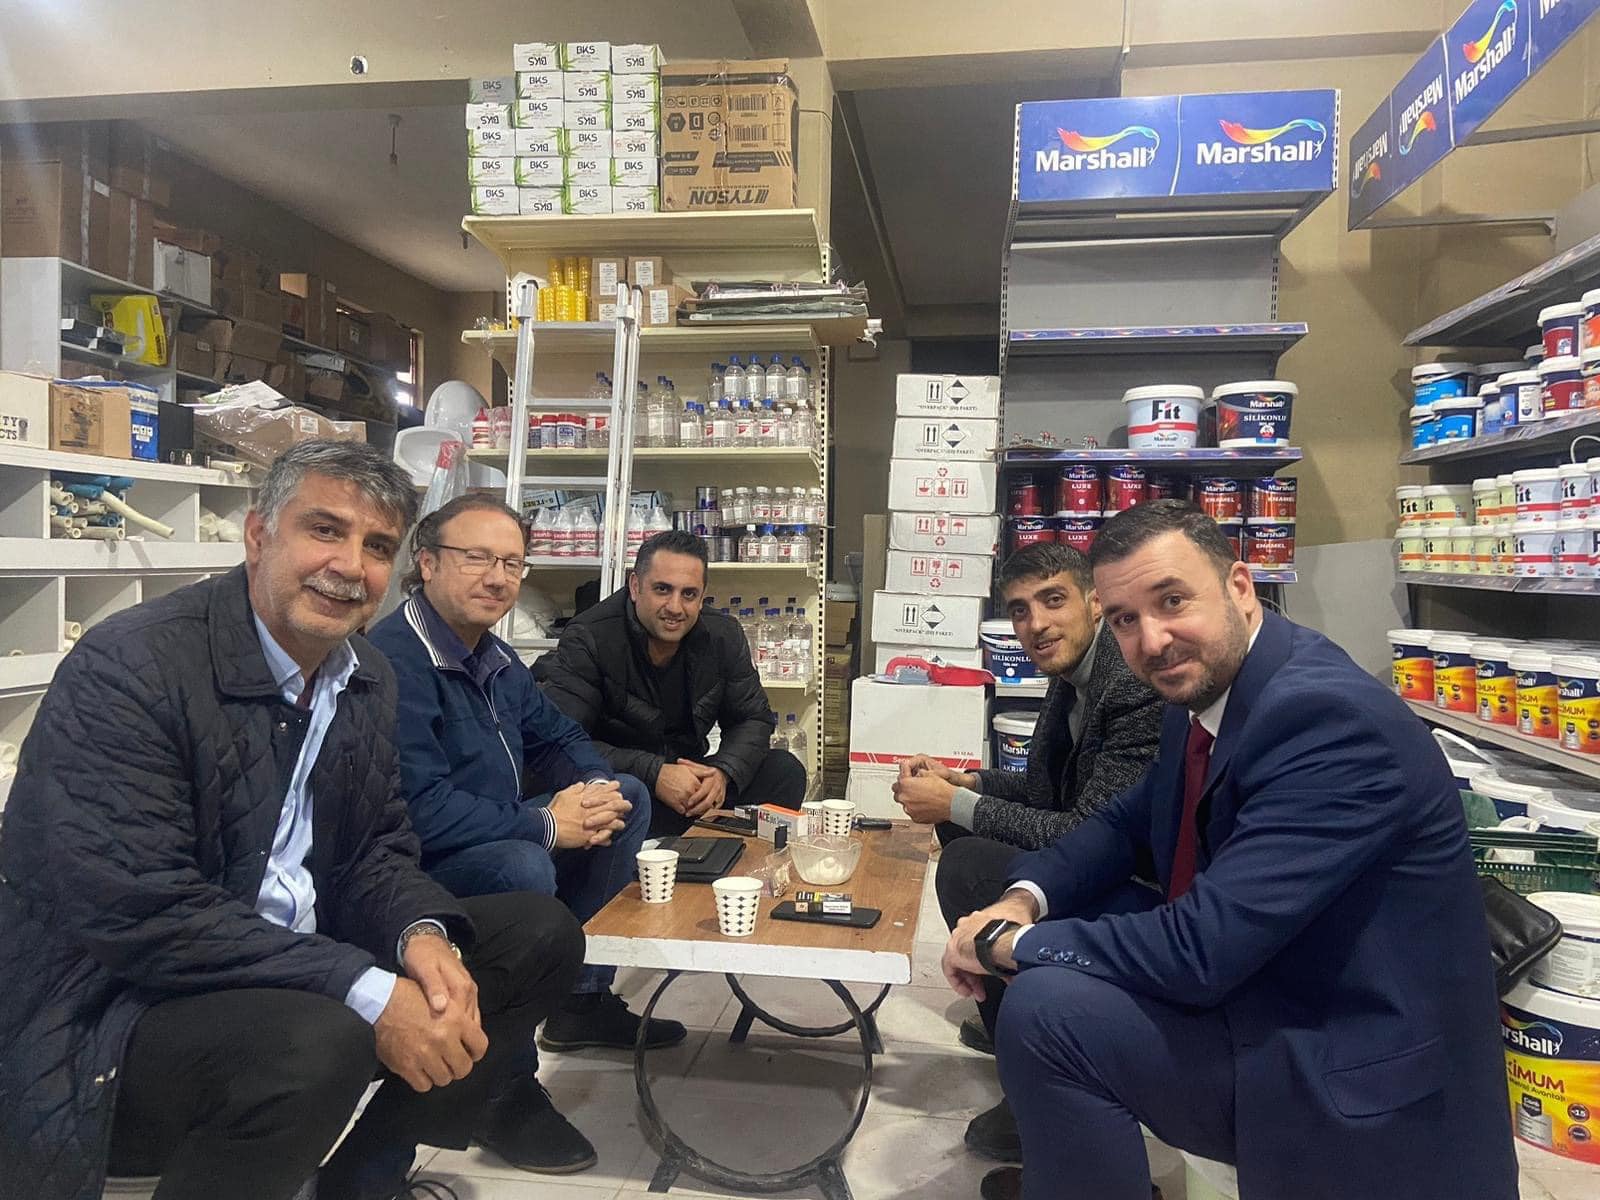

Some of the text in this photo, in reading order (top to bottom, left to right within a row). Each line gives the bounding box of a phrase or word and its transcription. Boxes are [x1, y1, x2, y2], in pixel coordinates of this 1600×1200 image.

[576, 46, 595, 54] BKS
[528, 56, 547, 66] BKS
[626, 58, 644, 66] BKS
[1455, 28, 1513, 104] Marshall
[529, 77, 548, 85] BKS
[578, 88, 597, 96] BKS
[626, 90, 645, 98] BKS
[529, 102, 547, 111] BKS
[1400, 74, 1443, 135] Marshall
[480, 116, 499, 124] BKS
[578, 116, 596, 125] BKS
[626, 118, 645, 127] BKS
[482, 132, 501, 140] BKS
[579, 134, 597, 142] BKS
[530, 144, 548, 152] BKS
[627, 144, 646, 152] BKS
[1197, 139, 1313, 165] Marshall
[1036, 147, 1148, 172] Marshall
[1354, 131, 1388, 180] Marshall
[482, 161, 500, 170] BKS
[530, 161, 548, 169] BKS
[578, 161, 596, 170] BKS
[624, 161, 643, 170] BKS
[486, 190, 504, 198] BKS
[579, 190, 598, 198] BKS
[689, 190, 753, 204] TYSON
[534, 203, 552, 211] BKS
[626, 202, 645, 210] BKS
[1152, 400, 1180, 421] Fit
[0, 416, 18, 427] TY
